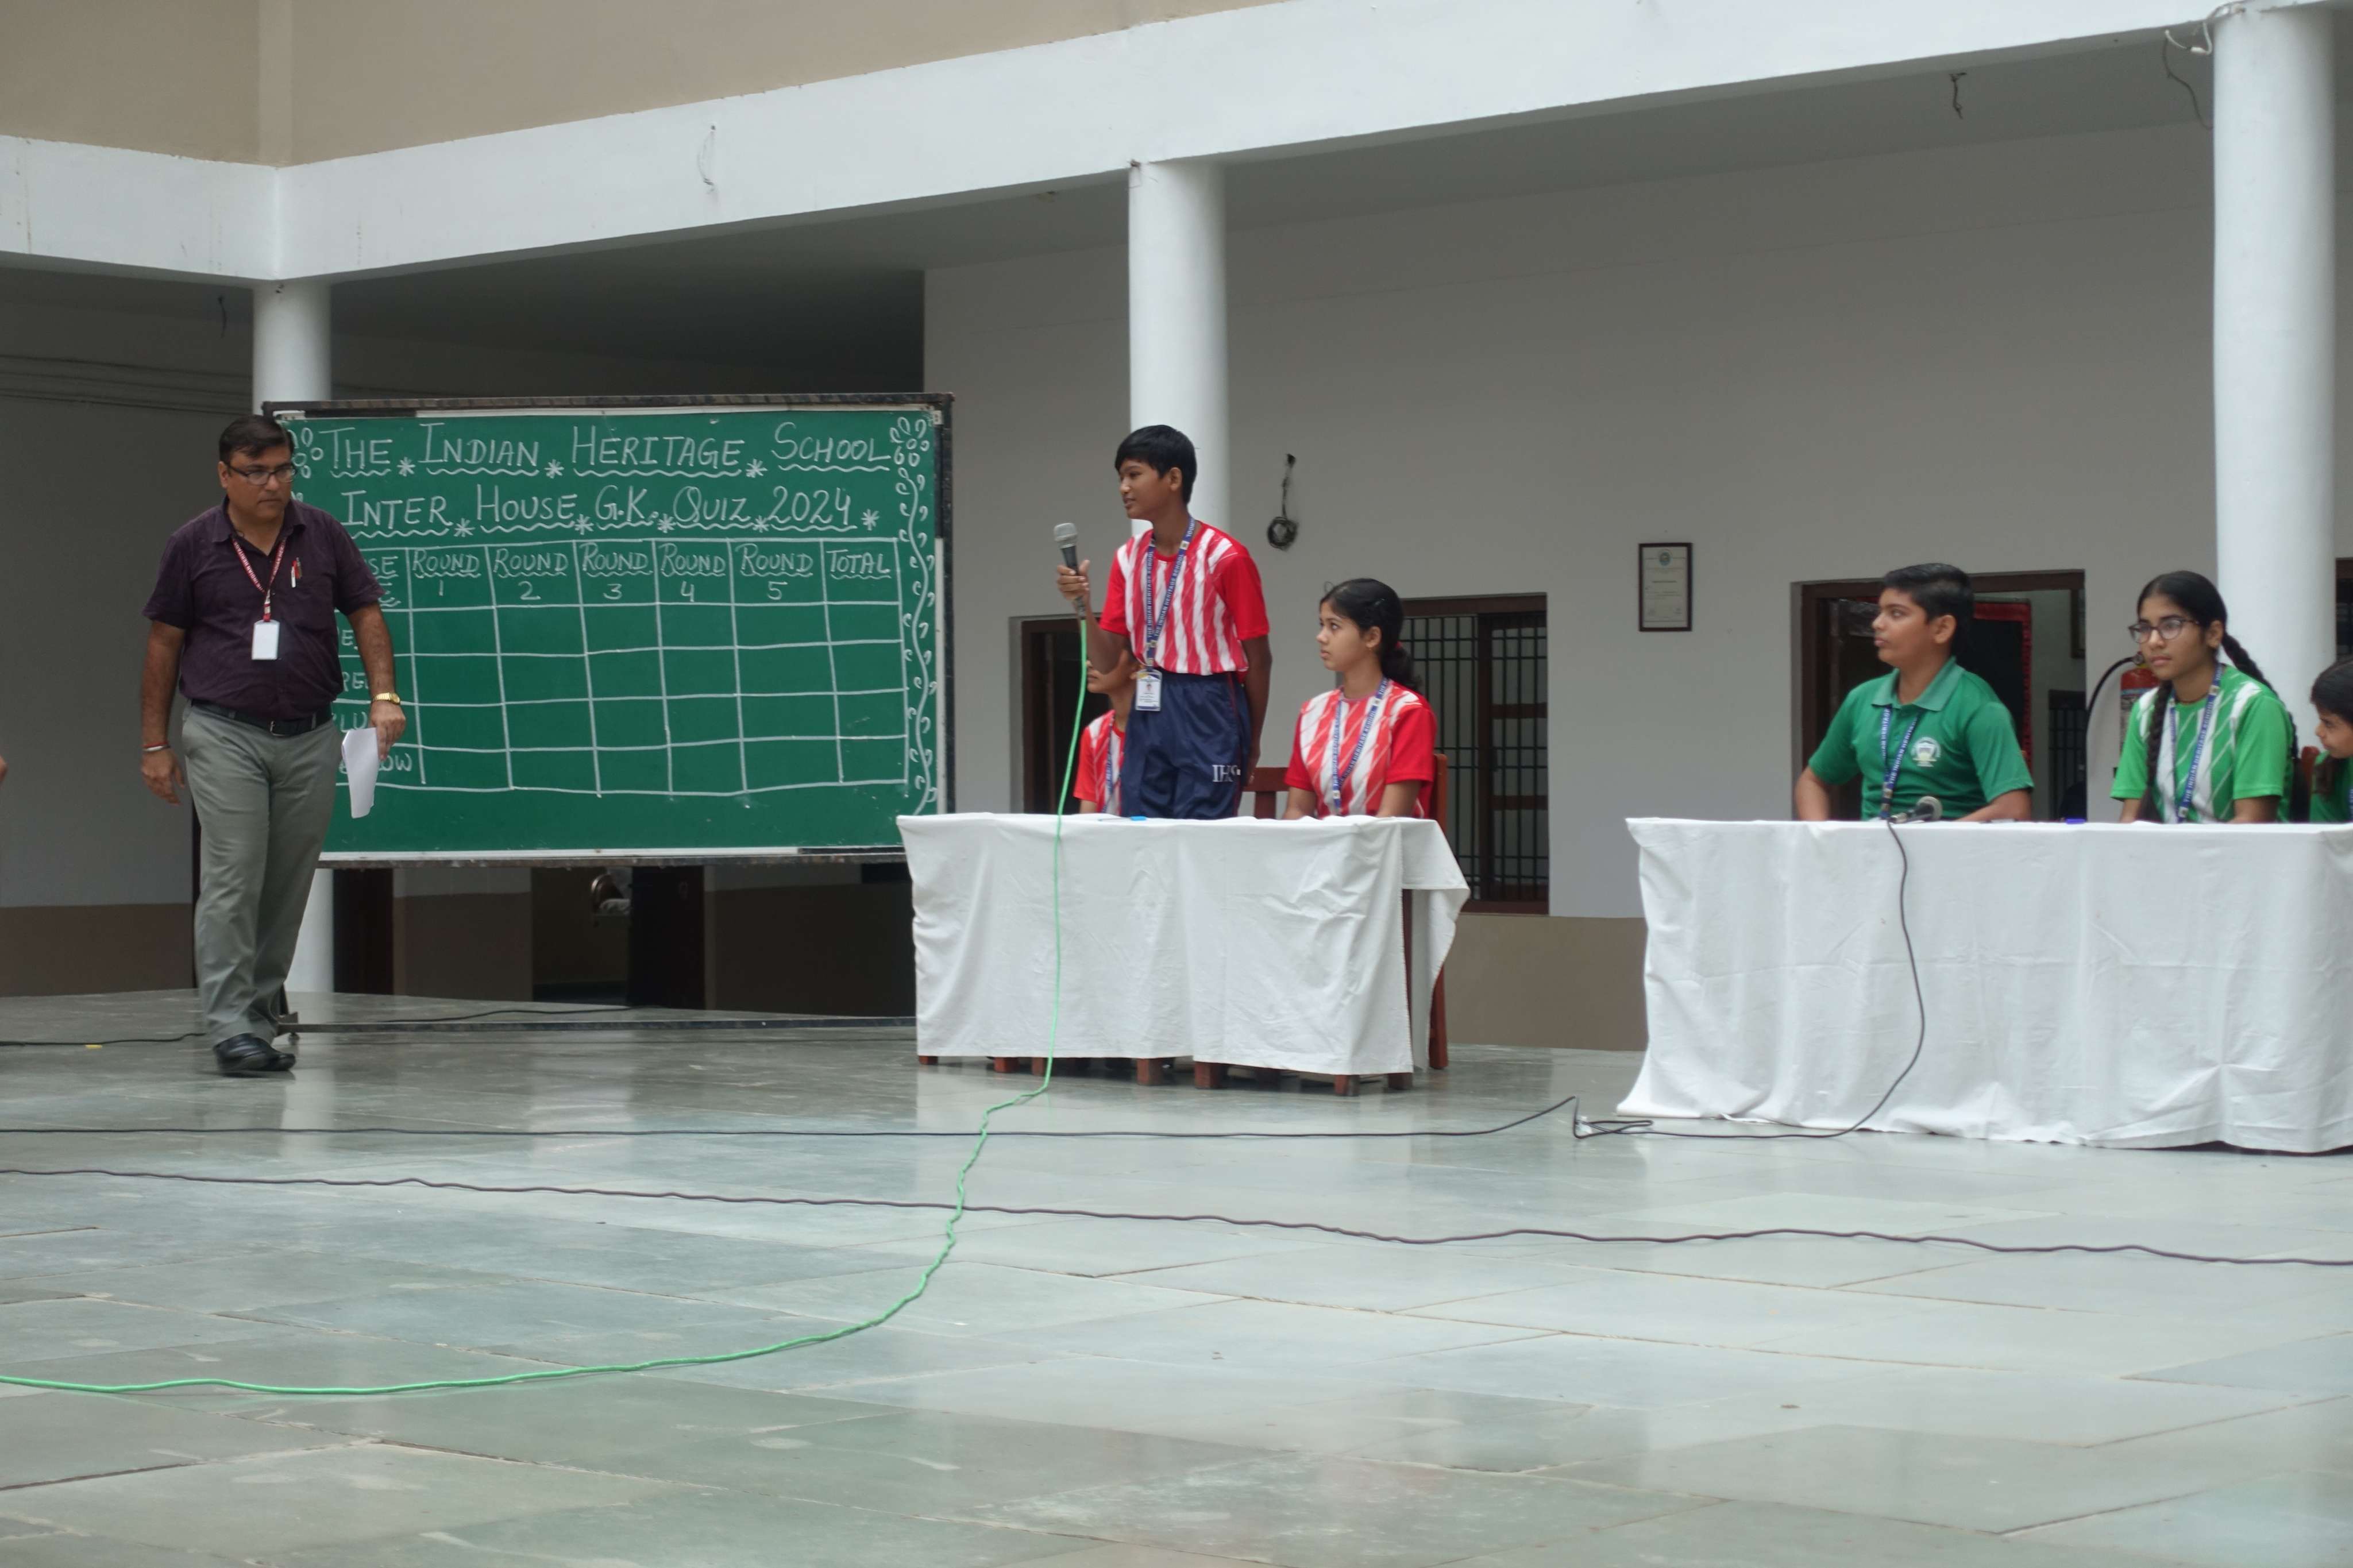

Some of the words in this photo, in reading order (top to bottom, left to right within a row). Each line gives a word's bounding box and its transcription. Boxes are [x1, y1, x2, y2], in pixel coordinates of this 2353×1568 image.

[319, 427, 392, 470] THE
[418, 423, 539, 466] INDIAN
[572, 425, 745, 469] HERITAGE
[772, 422, 891, 463] SCHOOL
[341, 490, 454, 530] INTER
[476, 484, 577, 522] HOUSE
[673, 486, 751, 522] QUIZ
[767, 486, 851, 525] 2024
[412, 549, 480, 574] ROUND
[493, 547, 569, 573] ROUND
[579, 542, 649, 573] ROUND
[658, 543, 726, 573] ROUND
[735, 542, 813, 574] ROUND
[827, 549, 890, 574] TOTAL
[438, 580, 443, 596] 1
[518, 581, 541, 600] 2
[603, 582, 622, 600] 3
[680, 581, 695, 602] 4
[767, 581, 788, 600] 5
[1158, 606, 1168, 625] INDIAN
[1166, 579, 1175, 605] HERITAGE
